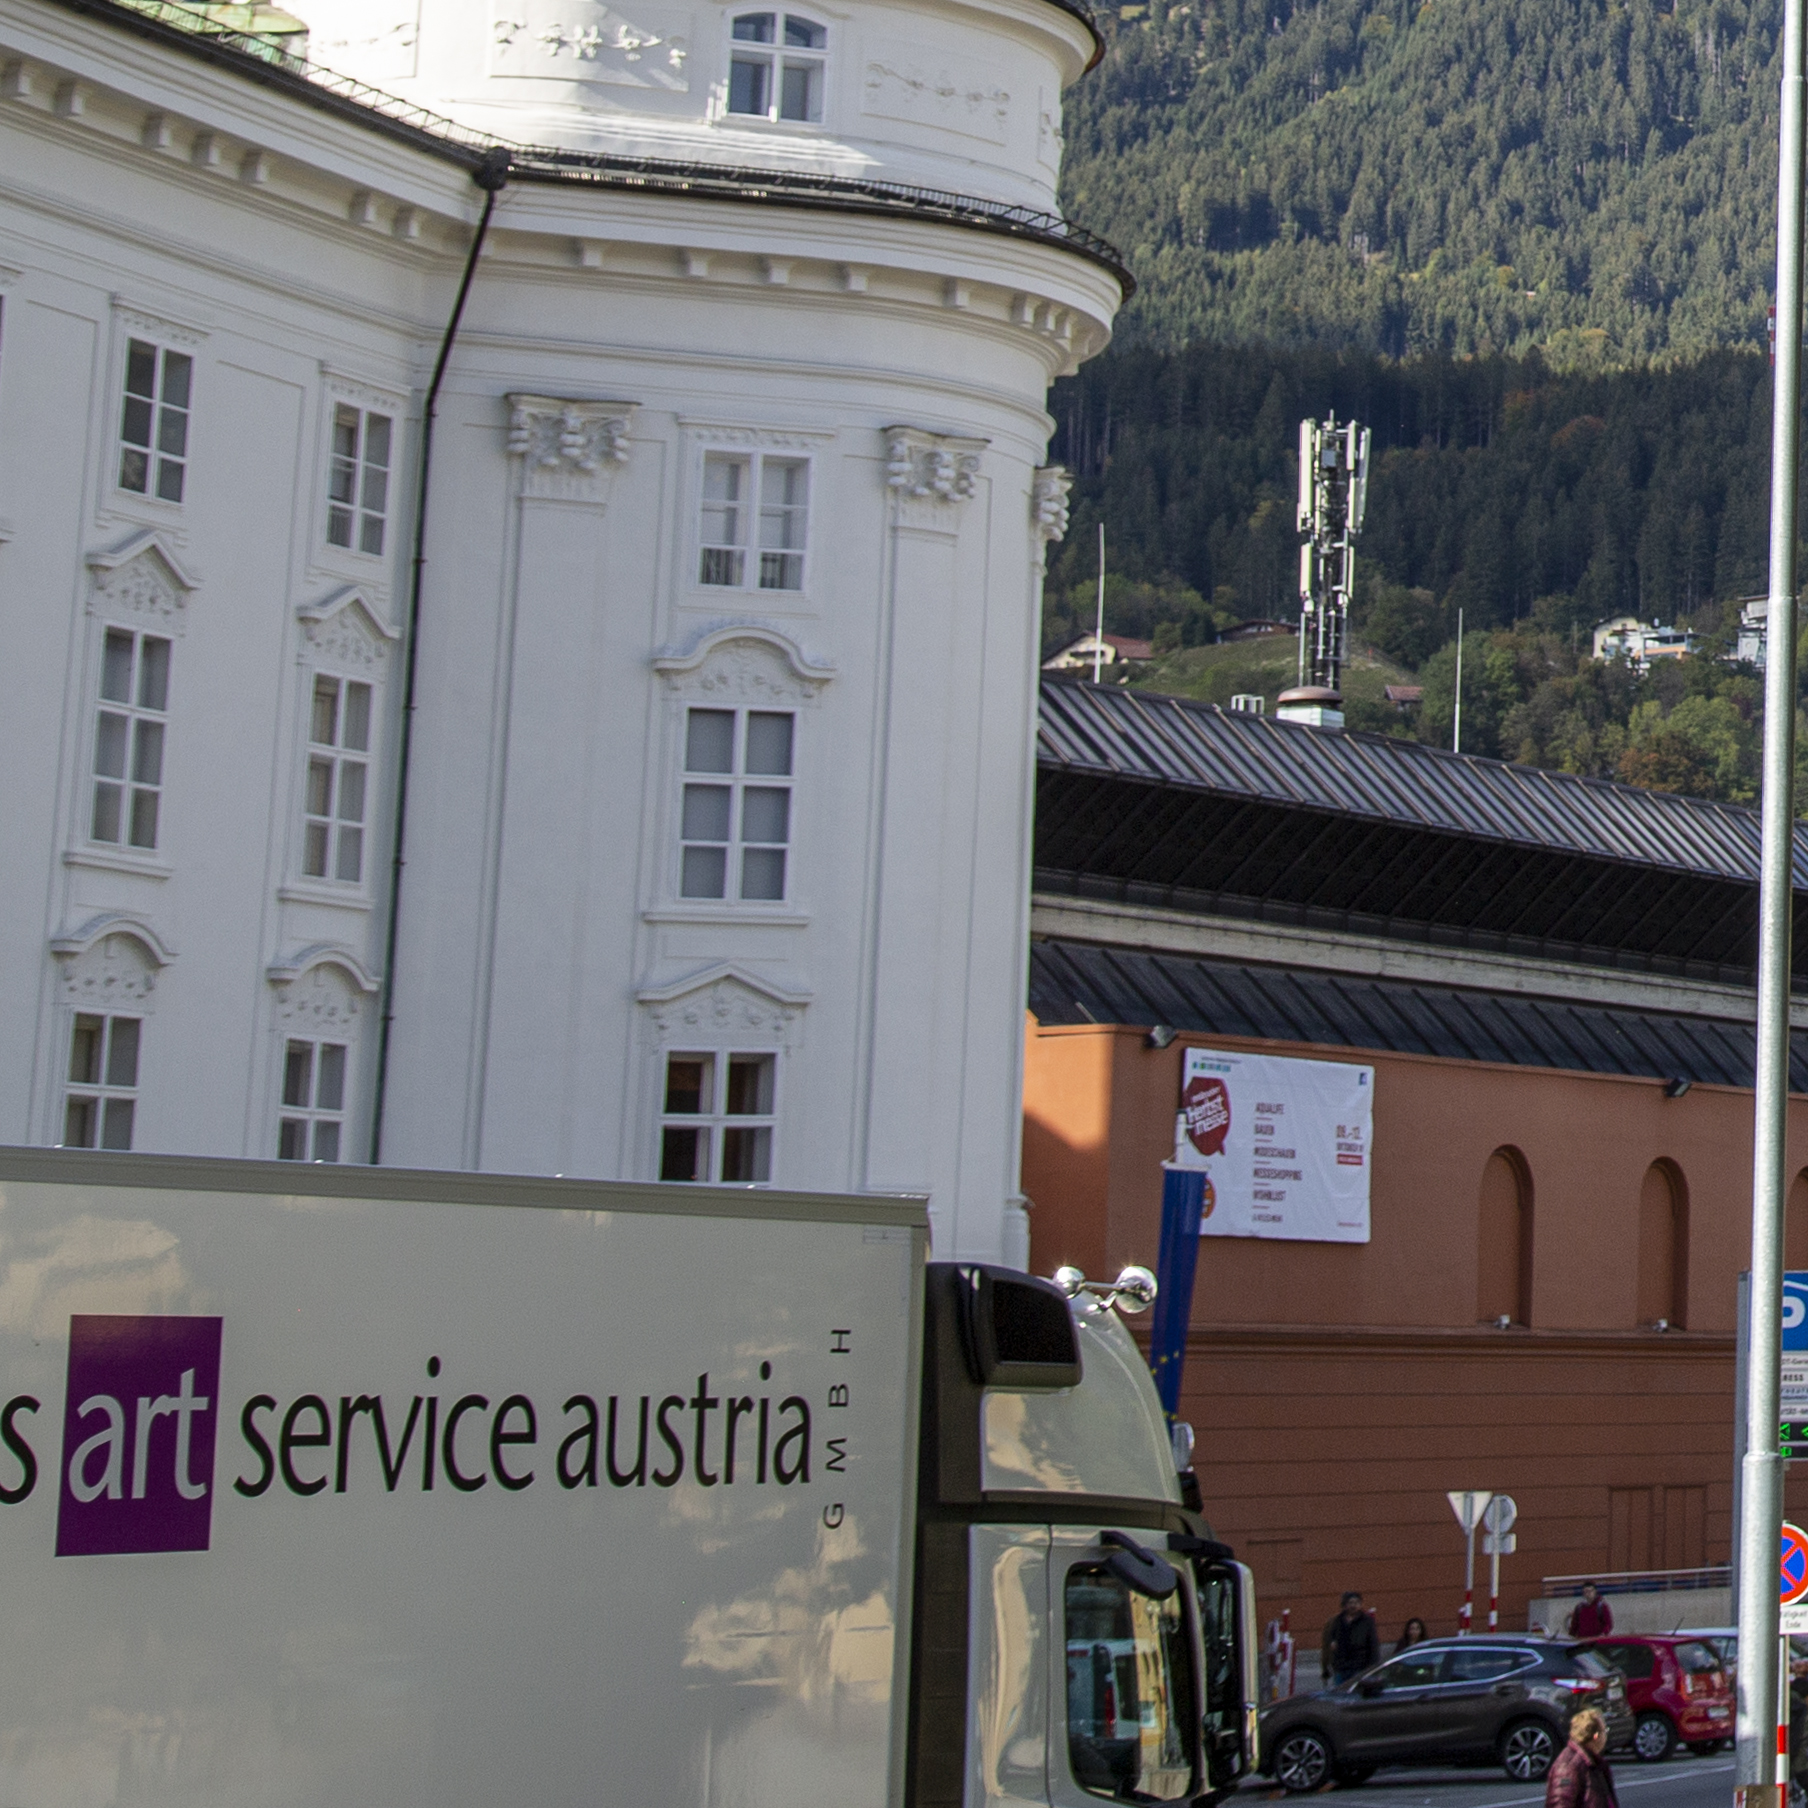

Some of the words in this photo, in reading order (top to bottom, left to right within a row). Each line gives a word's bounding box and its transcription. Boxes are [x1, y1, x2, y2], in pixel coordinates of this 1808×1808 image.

[68, 1368, 210, 1503] art
[232, 1355, 538, 1498] service
[555, 1360, 812, 1491] austria
[822, 1328, 852, 1530] GMBH
